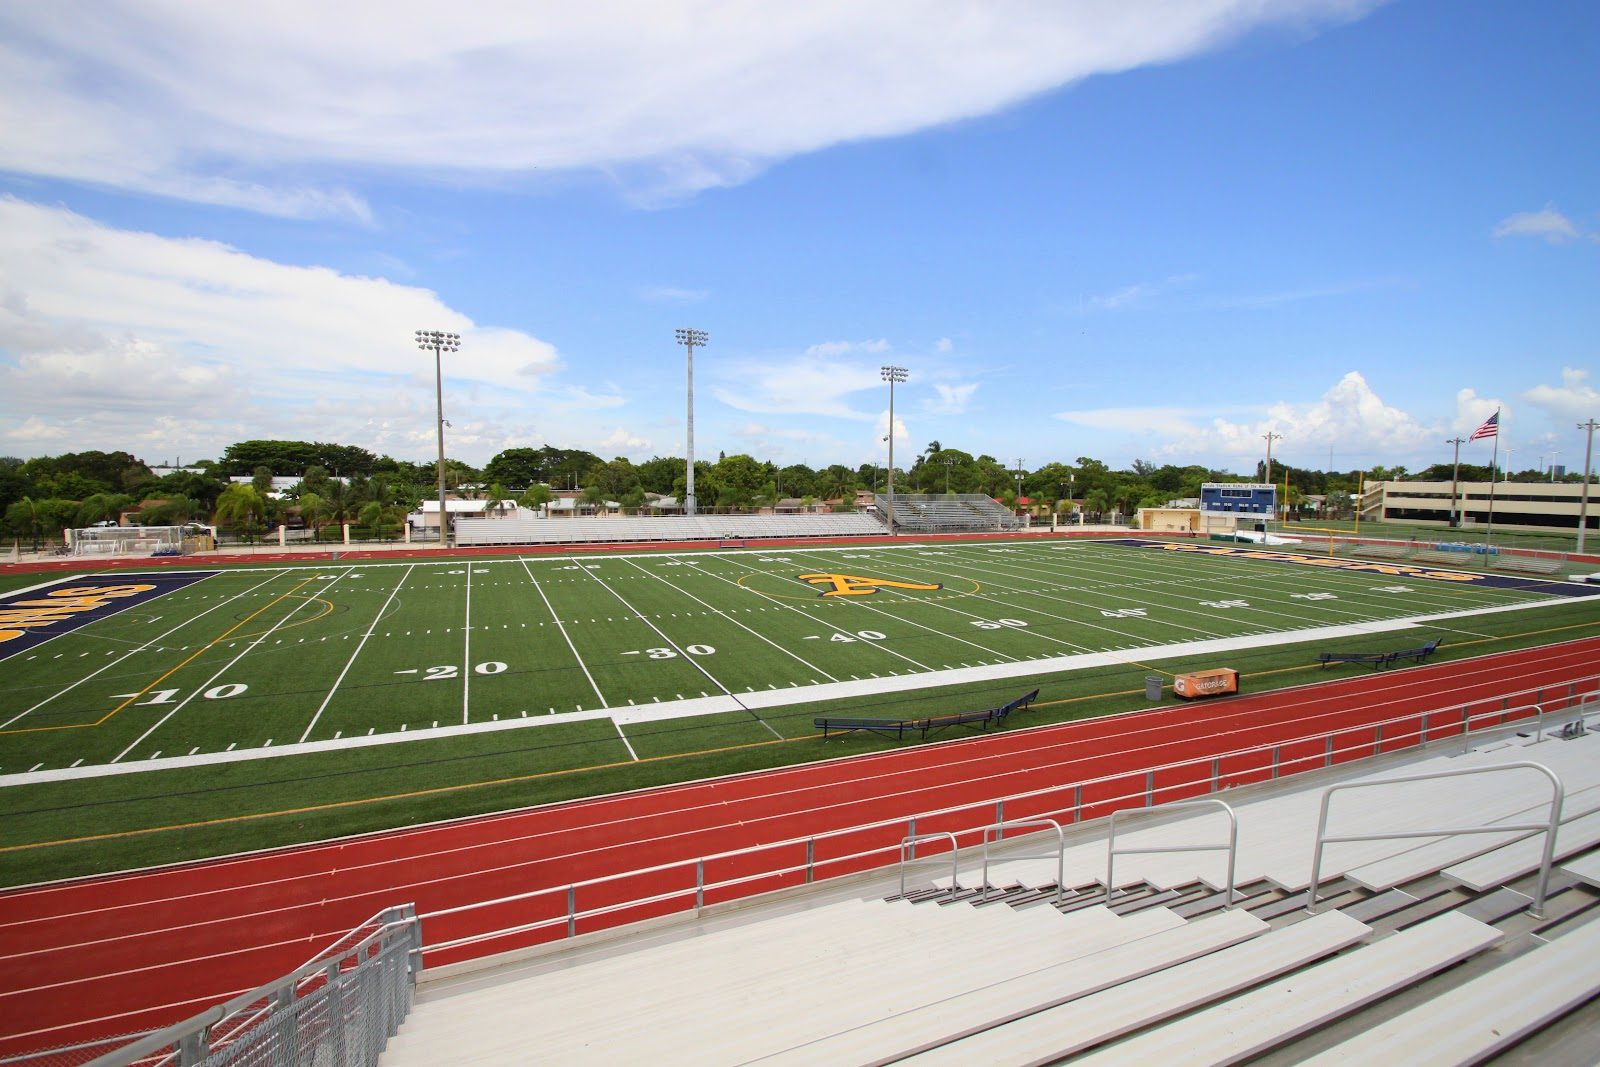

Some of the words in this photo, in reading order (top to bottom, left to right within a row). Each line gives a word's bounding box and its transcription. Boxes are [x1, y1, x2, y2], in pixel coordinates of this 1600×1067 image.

[970, 618, 1029, 630] 50
[829, 630, 887, 643] 40
[645, 643, 716, 660] 30
[423, 661, 508, 681] 20
[134, 683, 249, 706] 10
